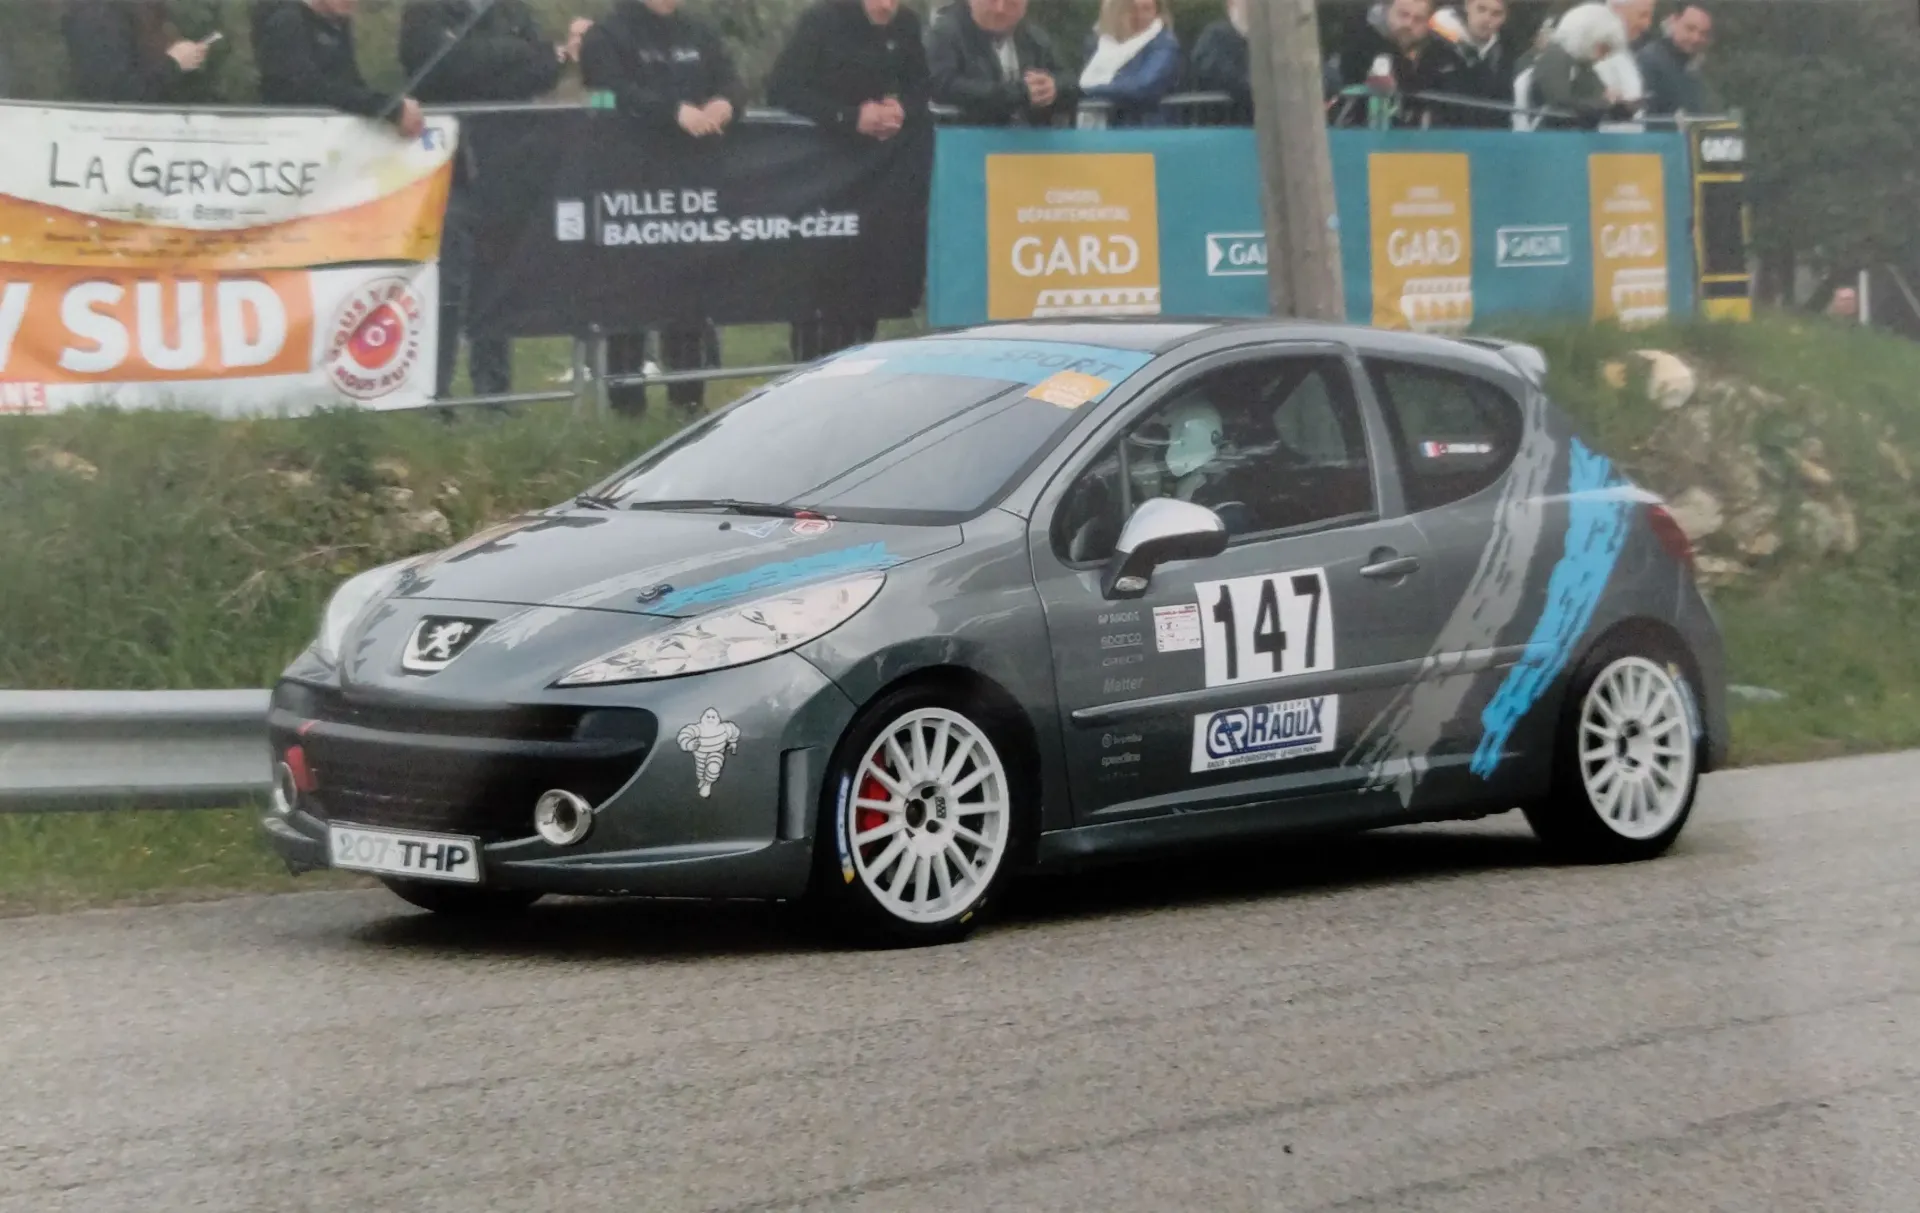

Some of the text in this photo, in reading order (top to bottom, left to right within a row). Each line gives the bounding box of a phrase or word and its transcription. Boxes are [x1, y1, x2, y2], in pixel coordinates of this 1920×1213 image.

[49, 141, 320, 196] LA GERVOISE
[603, 189, 718, 216] VILLE DE
[603, 208, 860, 247] BAGNOLS-SUR-CÈZE
[1387, 229, 1462, 266] GARD
[1011, 235, 1139, 276] GARD
[59, 278, 288, 373] SUD
[1213, 573, 1322, 680] 147
[1250, 697, 1325, 744] RAOUX
[338, 832, 470, 873] 207 THP
